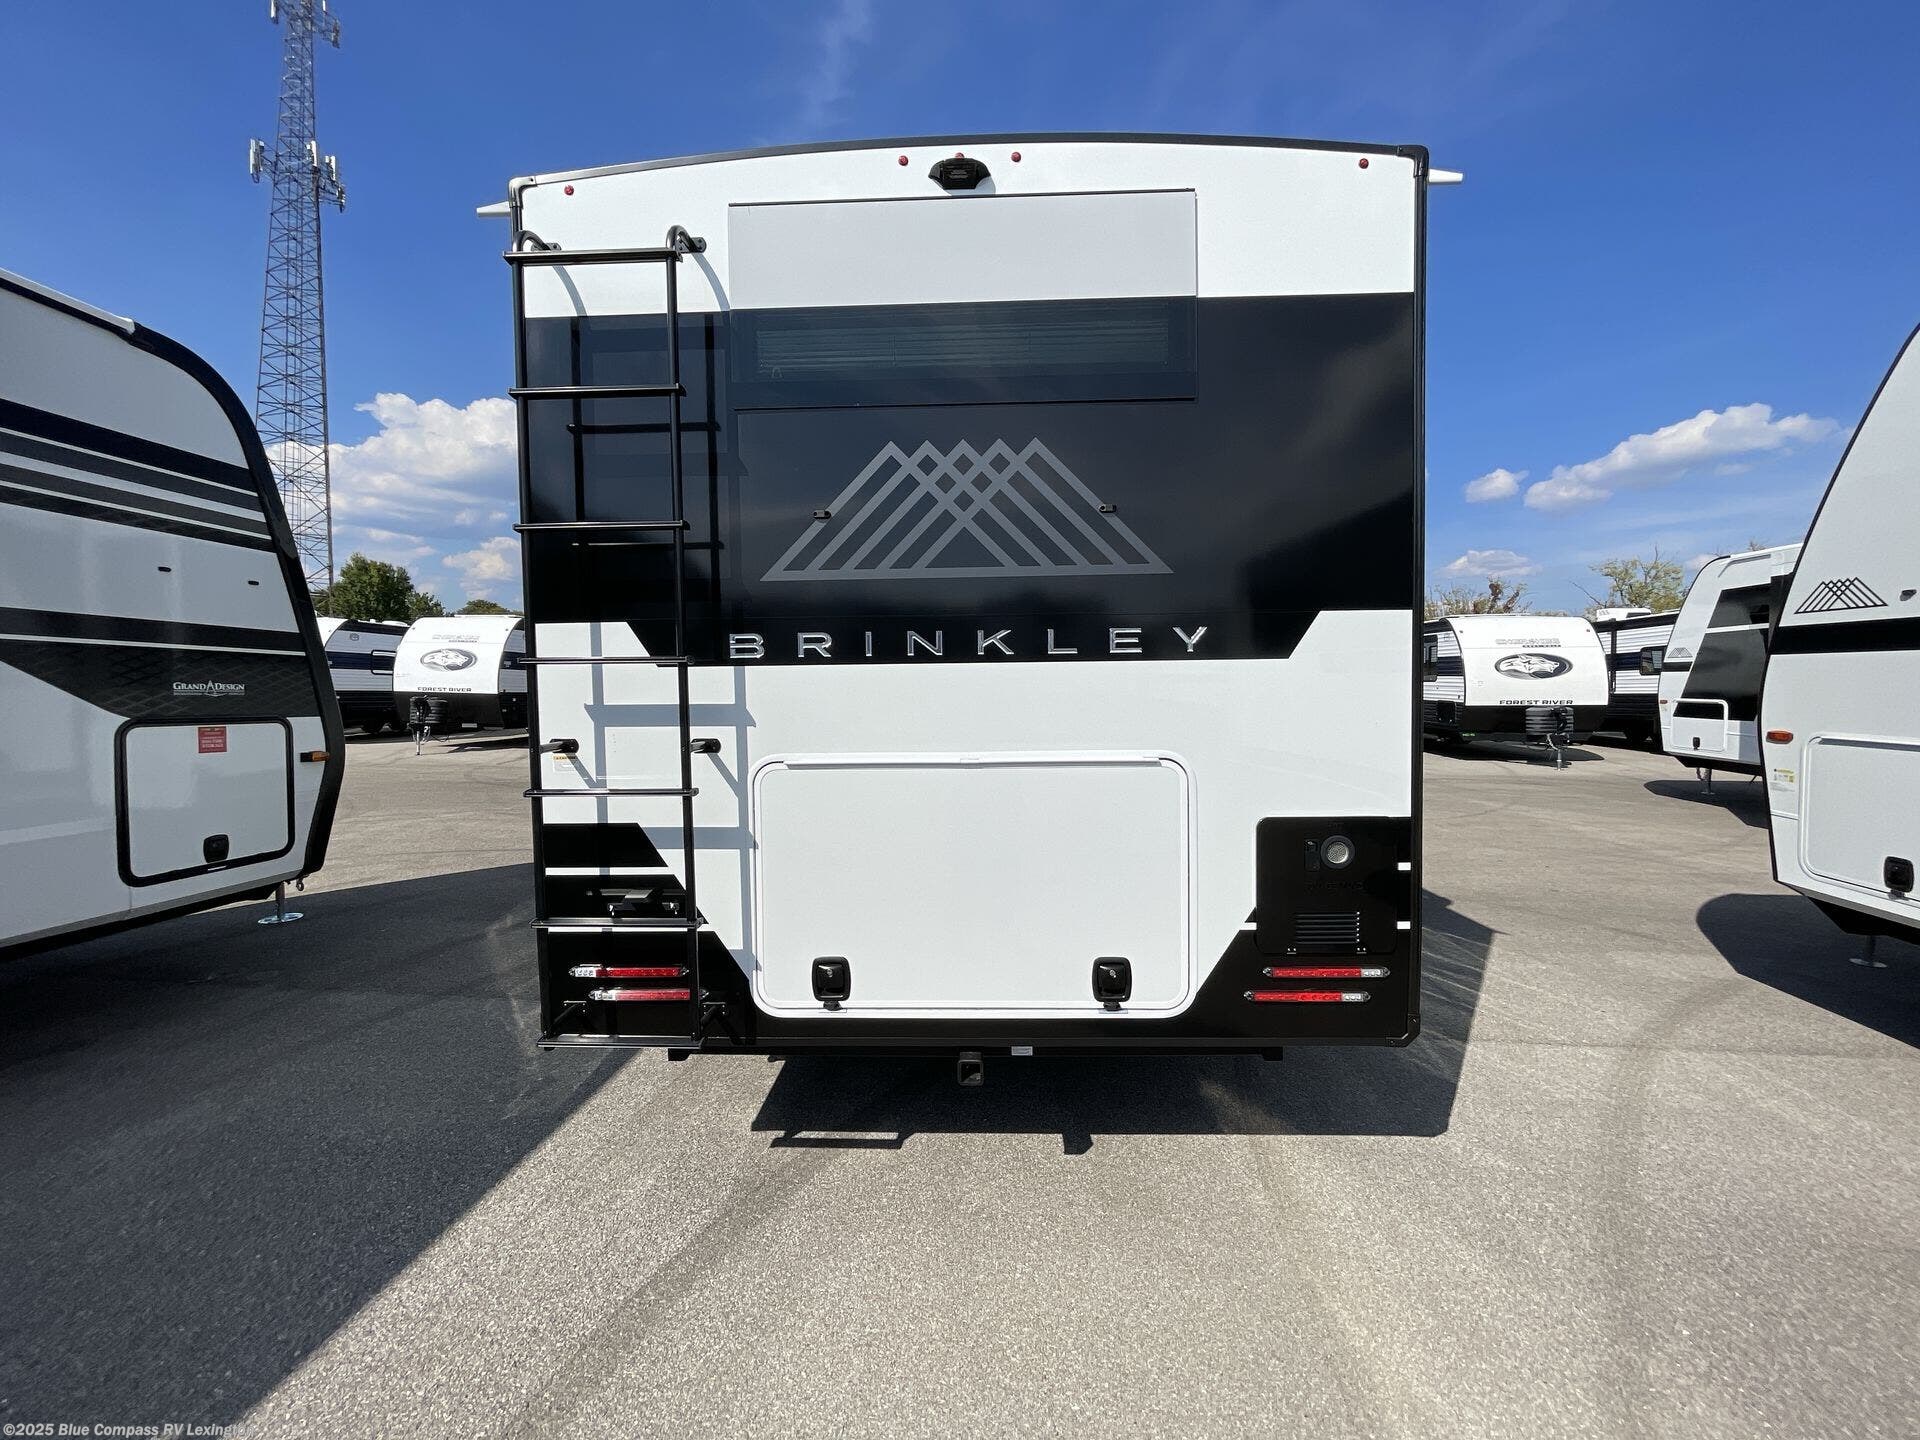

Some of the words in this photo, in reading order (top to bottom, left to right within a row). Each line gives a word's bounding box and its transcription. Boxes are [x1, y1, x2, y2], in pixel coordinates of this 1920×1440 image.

[729, 626, 1207, 659] BRINKLEY
[173, 681, 206, 690] GRAND
[215, 682, 245, 690] DESIGN
